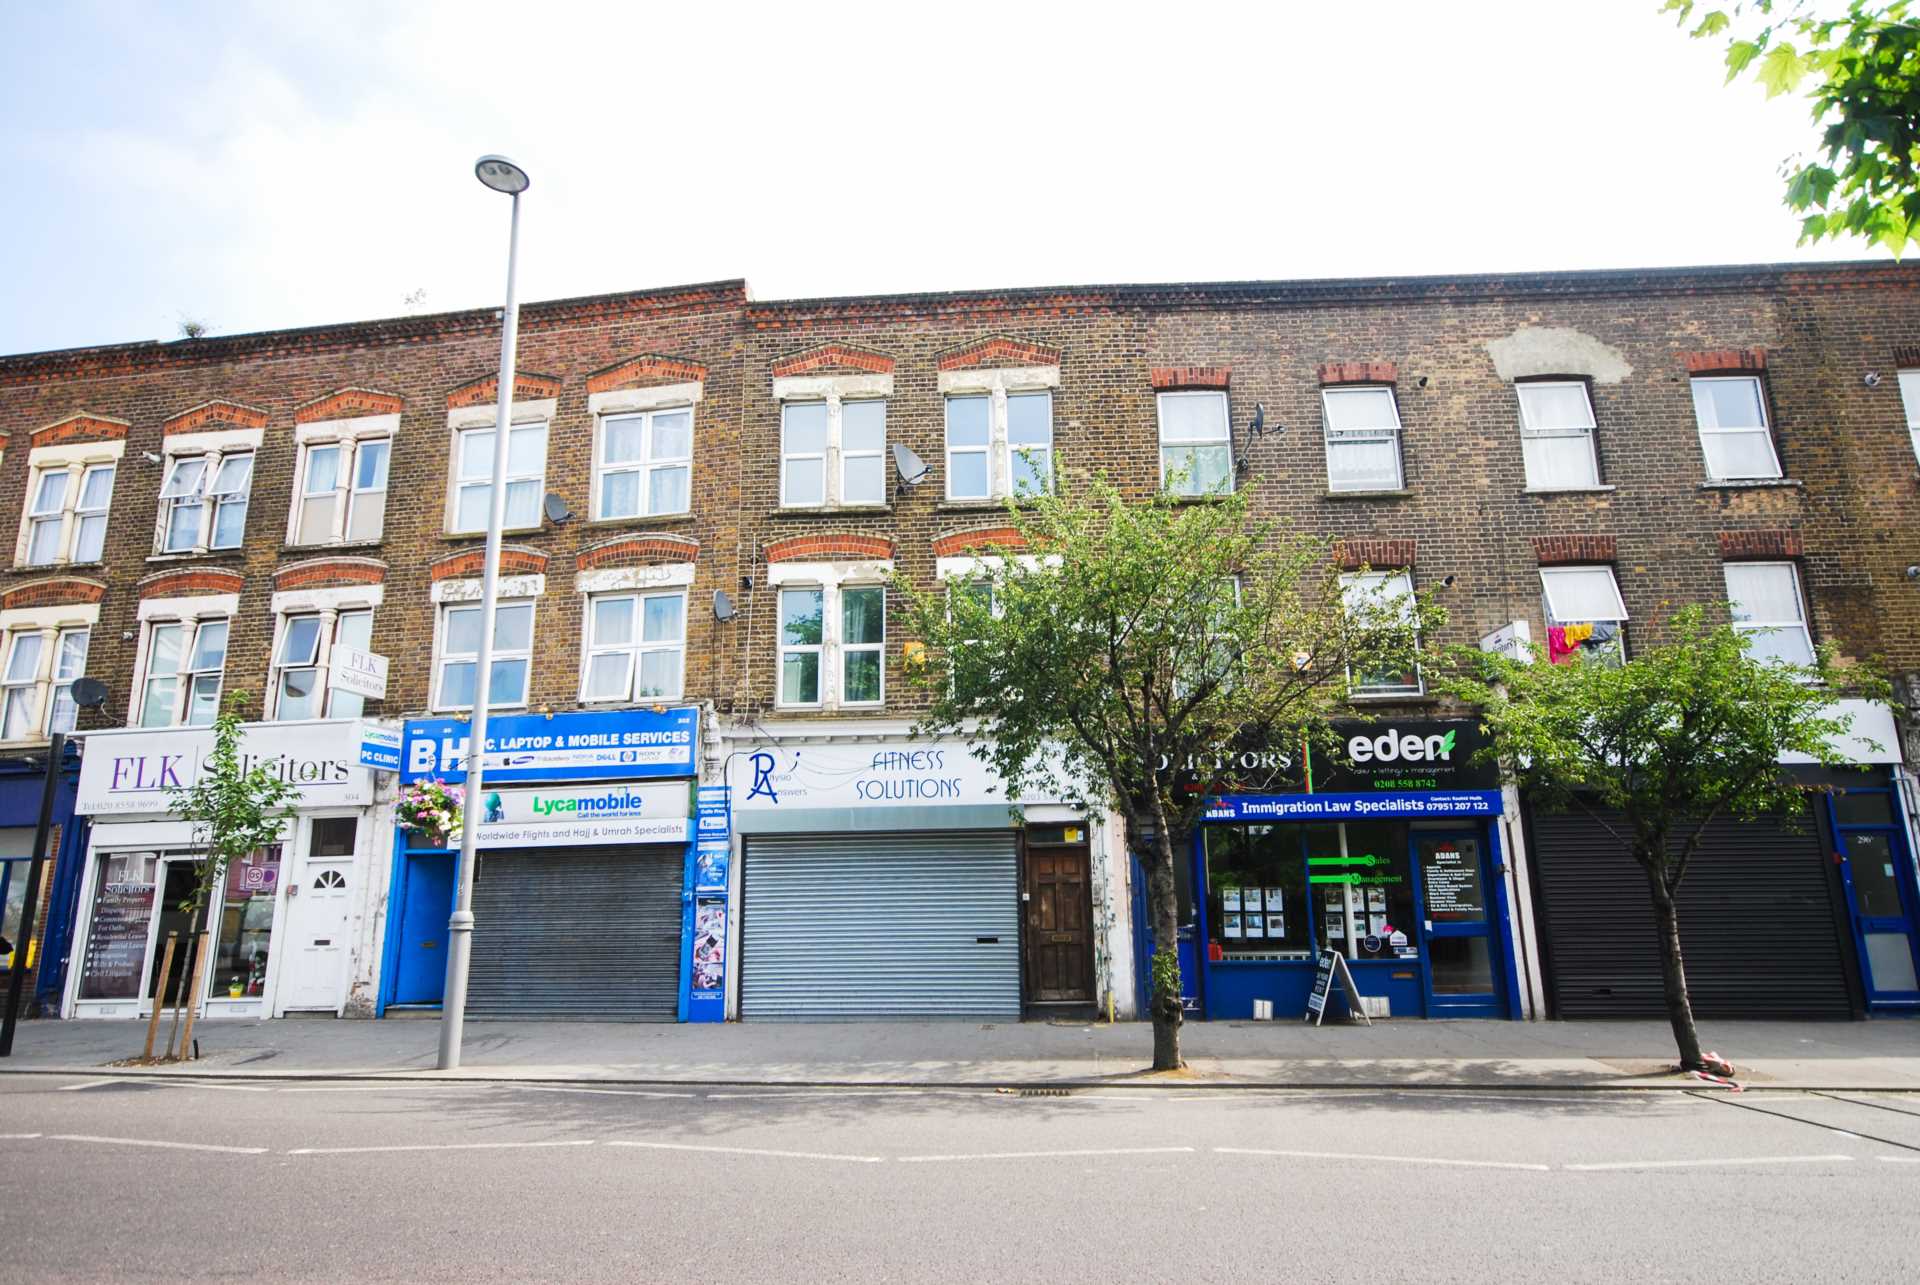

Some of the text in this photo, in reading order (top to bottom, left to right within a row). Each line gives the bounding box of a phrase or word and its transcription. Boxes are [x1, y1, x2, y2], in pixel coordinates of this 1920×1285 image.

[501, 735, 551, 749] LAPTOP
[555, 735, 564, 747] &
[568, 733, 619, 747] MOBILE
[623, 730, 690, 745] SERVICES
[1348, 728, 1450, 762] eden
[361, 750, 399, 764] PC CLINIC
[873, 751, 945, 771] FITNESS
[110, 755, 184, 789] FLK
[856, 778, 962, 800] SOLUTIONS
[1374, 779, 1437, 789] 0208 558 8742
[532, 792, 642, 815] Lycamobile
[1241, 801, 1323, 816] Immigration
[1324, 800, 1351, 812] Law
[1354, 799, 1425, 814] Specialists
[1426, 802, 1454, 811] 07951
[1454, 802, 1470, 810] 207
[1473, 801, 1489, 810] 122
[522, 830, 549, 841] Flights
[552, 829, 570, 838] and
[573, 828, 591, 839] Hajj
[593, 828, 599, 836] &
[602, 827, 632, 836] Umrah
[635, 825, 683, 837] Specialists
